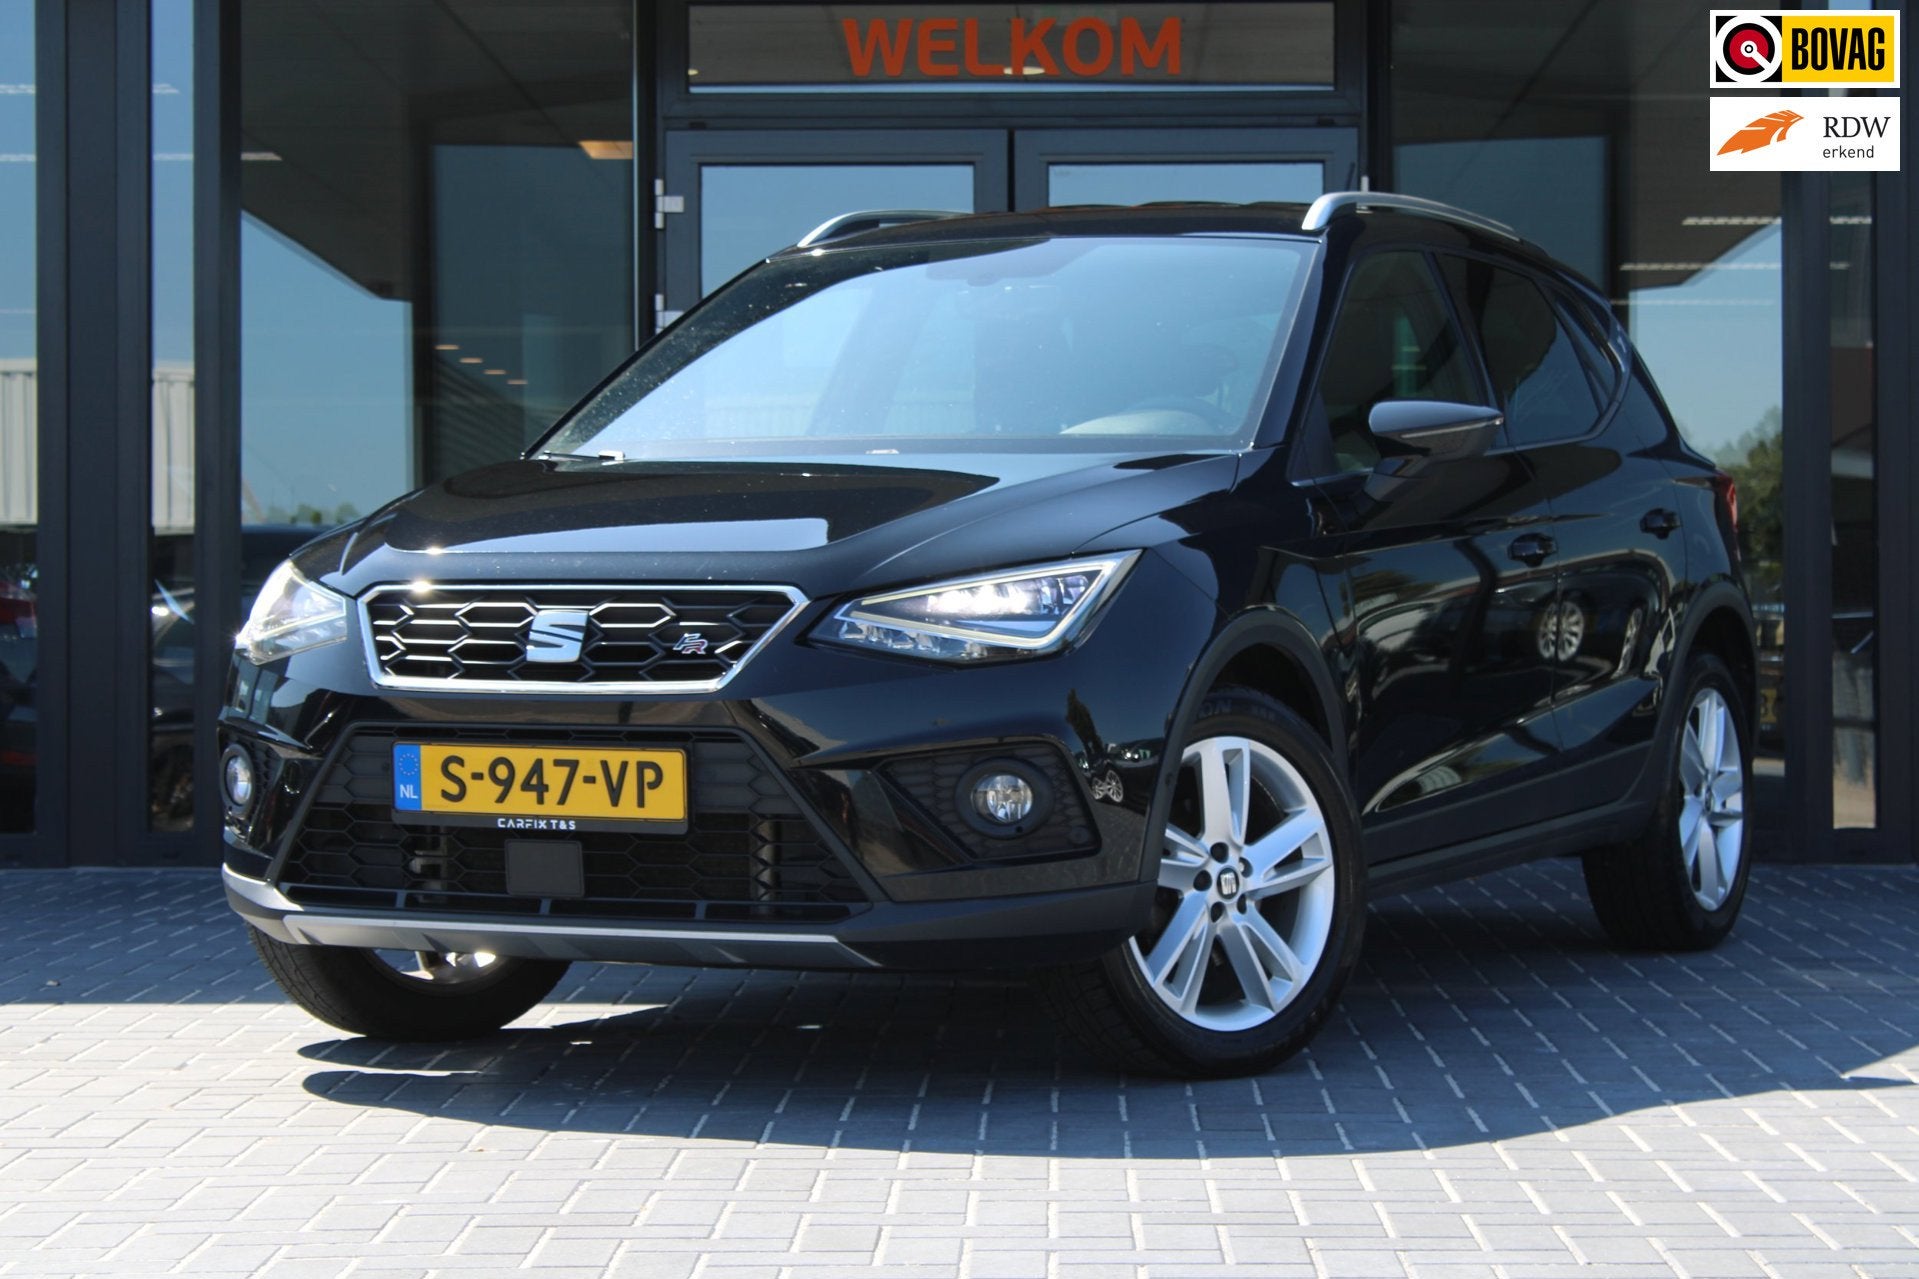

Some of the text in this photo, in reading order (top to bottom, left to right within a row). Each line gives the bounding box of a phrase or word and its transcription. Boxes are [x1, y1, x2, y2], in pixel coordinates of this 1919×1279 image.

[842, 16, 1182, 76] WELKOM
[400, 784, 418, 799] NL
[440, 755, 664, 808] S-947-VP
[497, 818, 576, 830] CARFIX T&S
